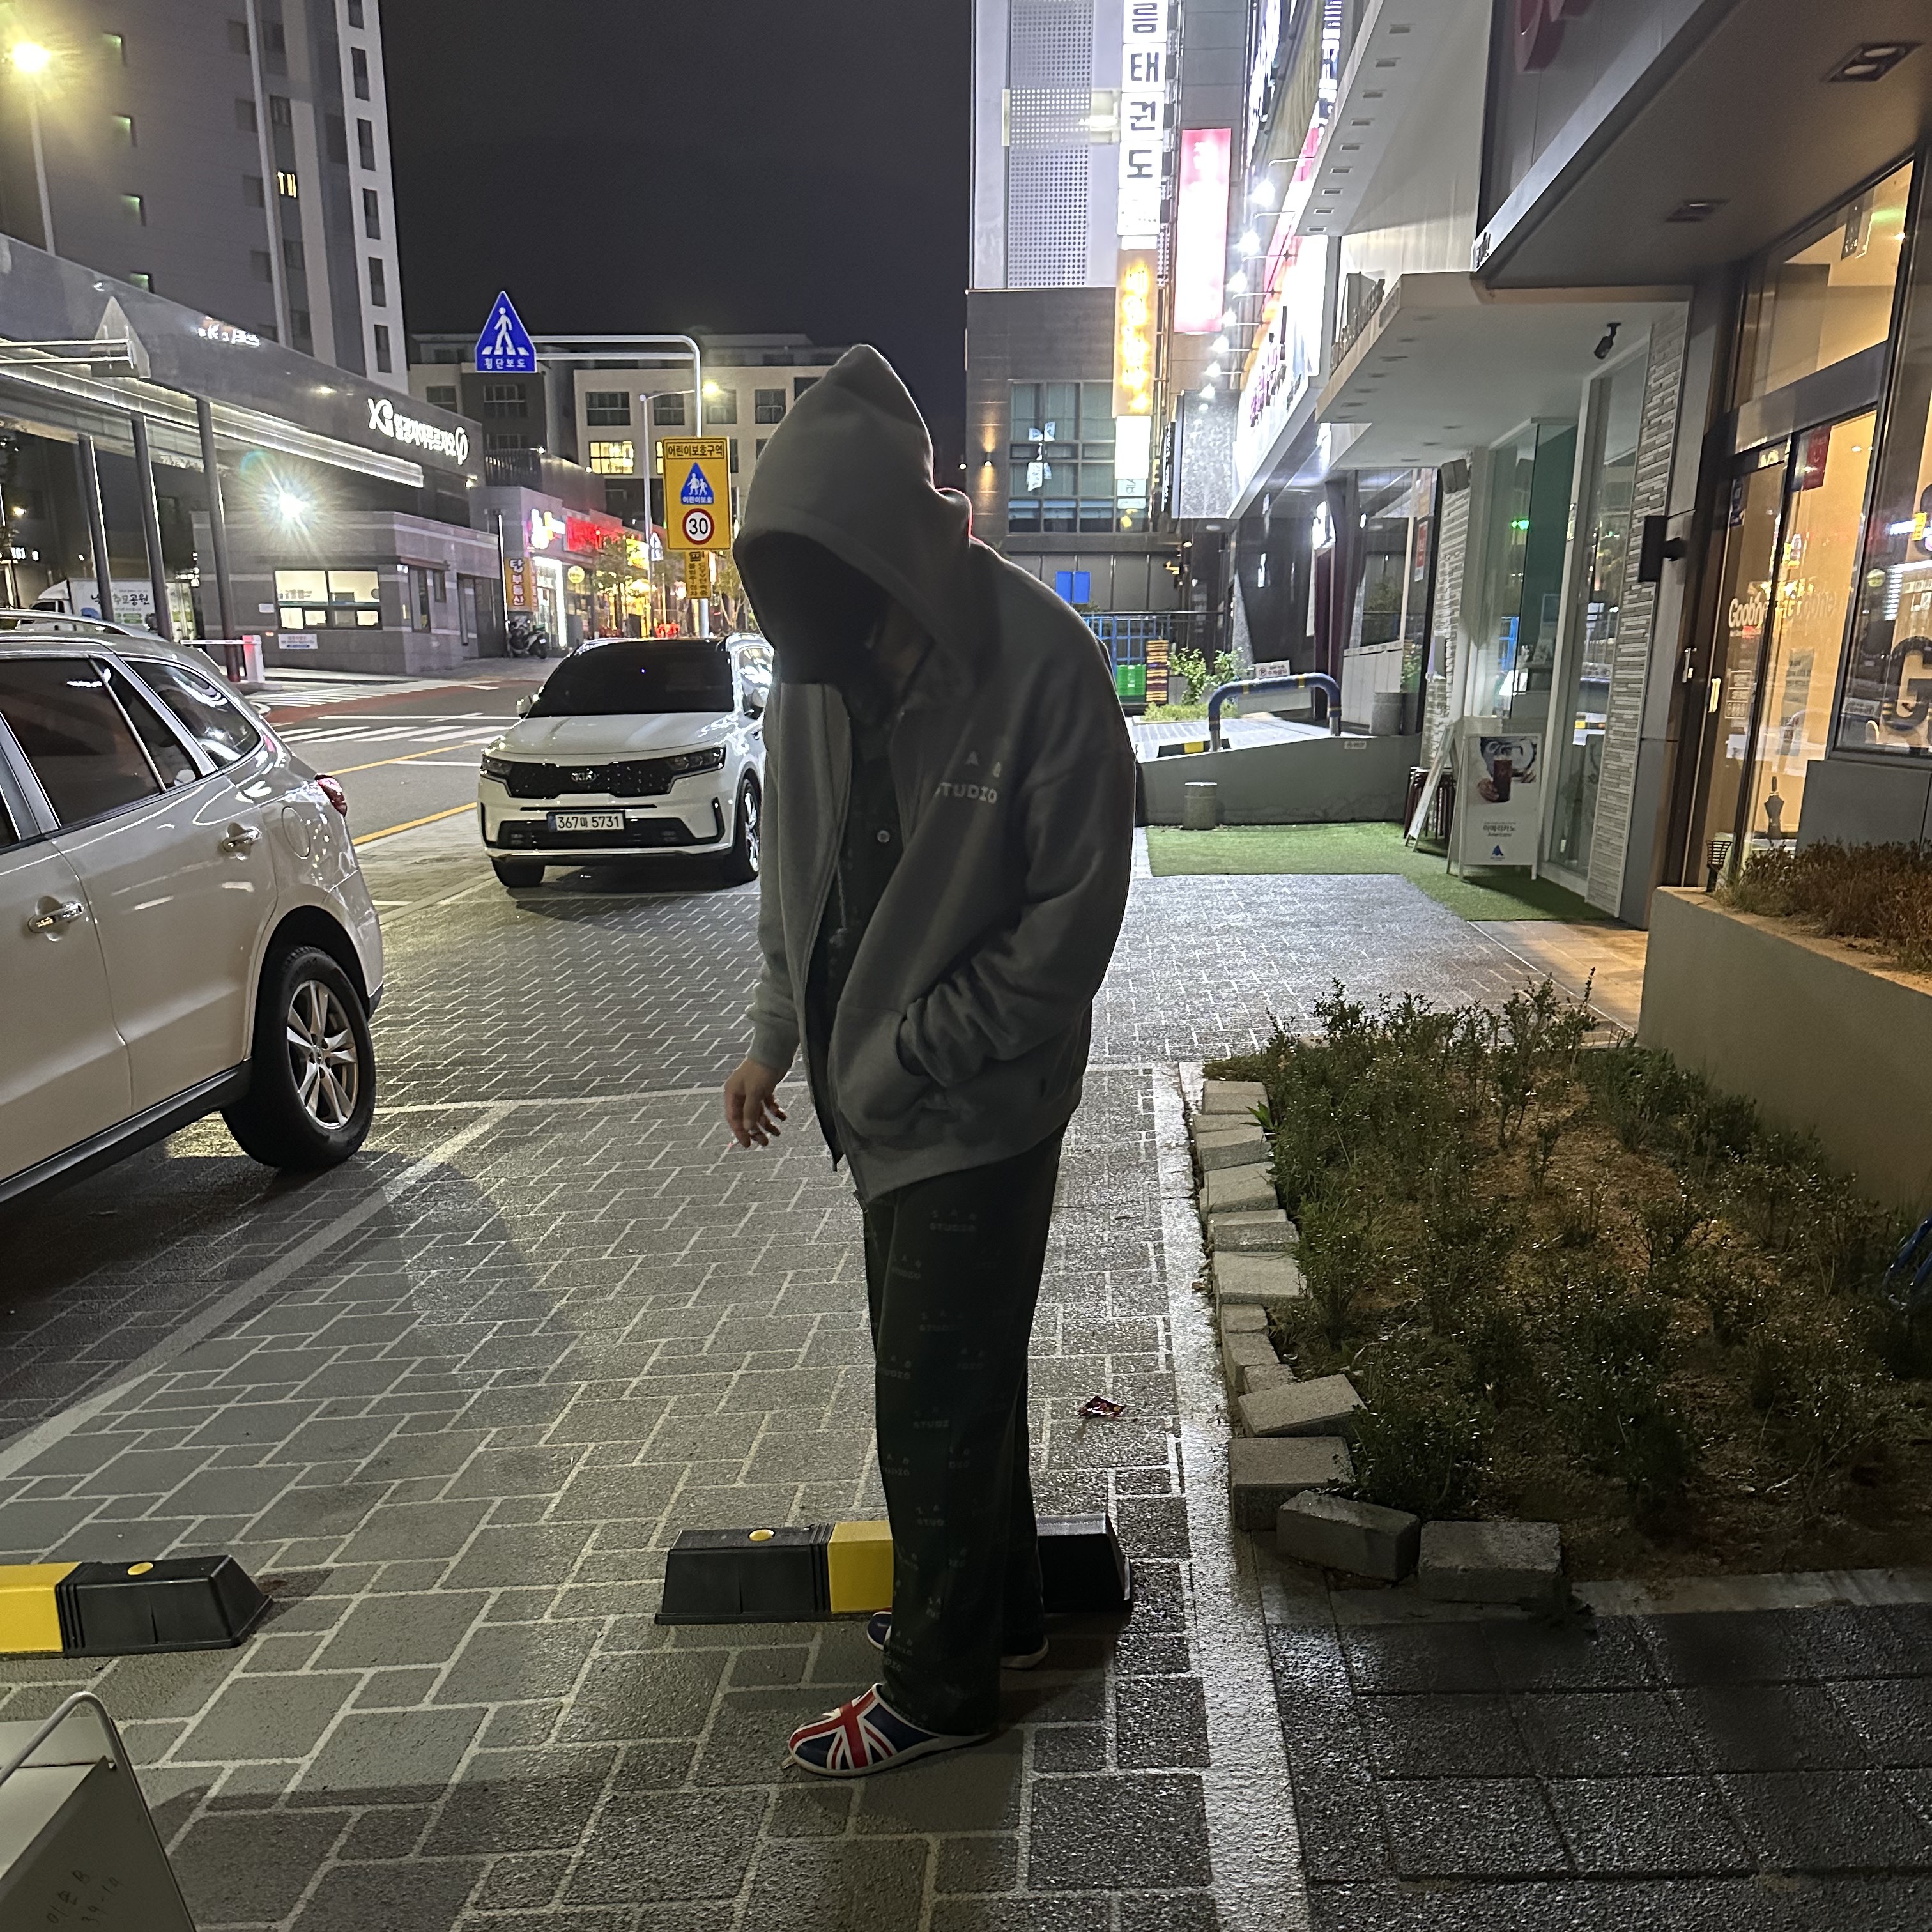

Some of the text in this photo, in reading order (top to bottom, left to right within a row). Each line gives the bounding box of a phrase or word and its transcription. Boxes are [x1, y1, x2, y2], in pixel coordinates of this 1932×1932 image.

[484, 357, 526, 369] 횡단보도
[668, 445, 723, 457] 어린이보호구역
[688, 518, 709, 535] 30
[592, 815, 620, 829] 5731
